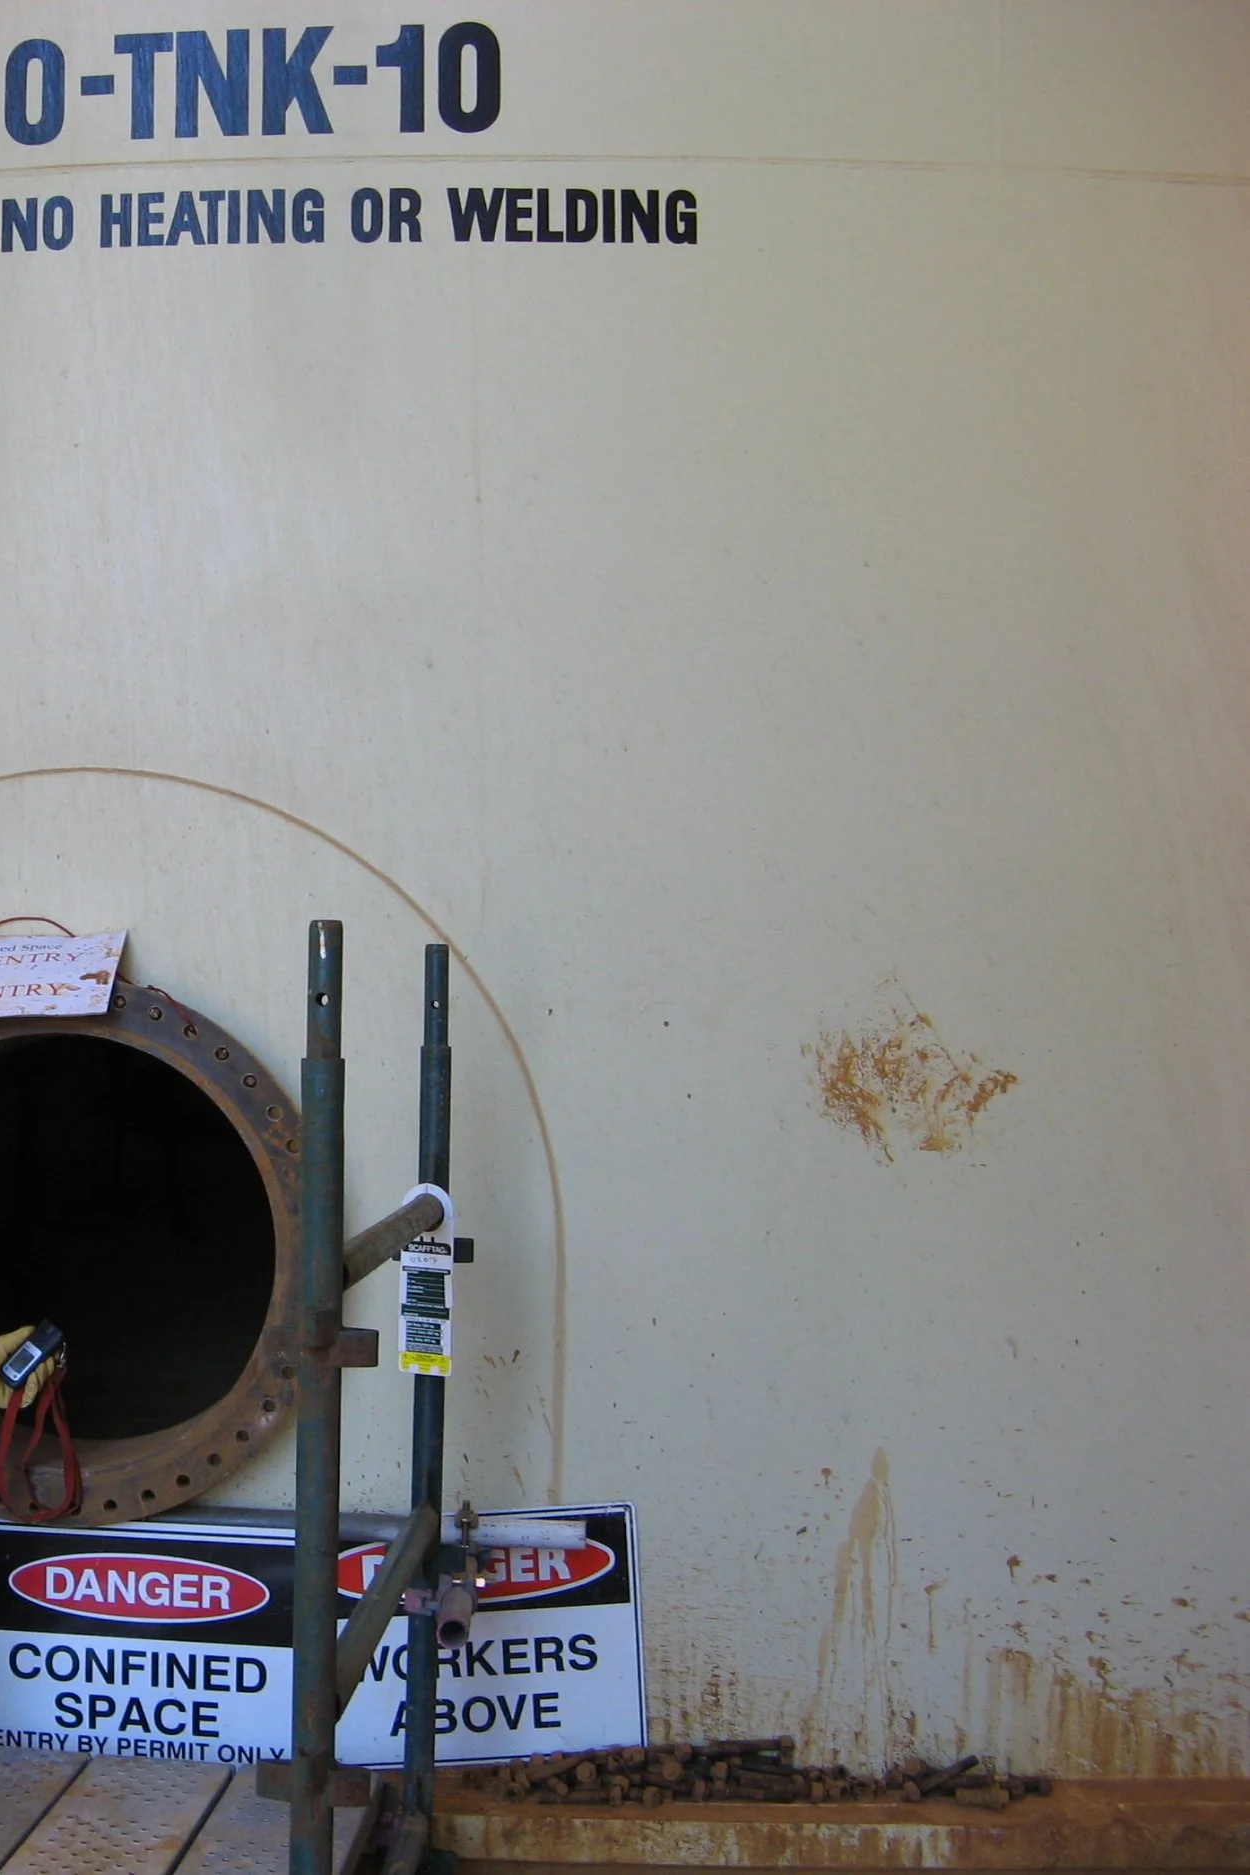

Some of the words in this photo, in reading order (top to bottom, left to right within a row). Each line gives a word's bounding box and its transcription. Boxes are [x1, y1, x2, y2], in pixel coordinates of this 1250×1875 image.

[100, 188, 325, 248] HEATING
[350, 187, 422, 244] OR
[447, 187, 698, 245] WELDING
[21, 943, 63, 952] Space
[408, 1243, 445, 1253] SCAFFTAG
[45, 1566, 230, 1610] DANGER
[8, 1642, 268, 1694] CONFINED
[54, 1692, 221, 1738] SPACE
[77, 1735, 108, 1754] BY
[117, 1738, 209, 1760] PERMIT
